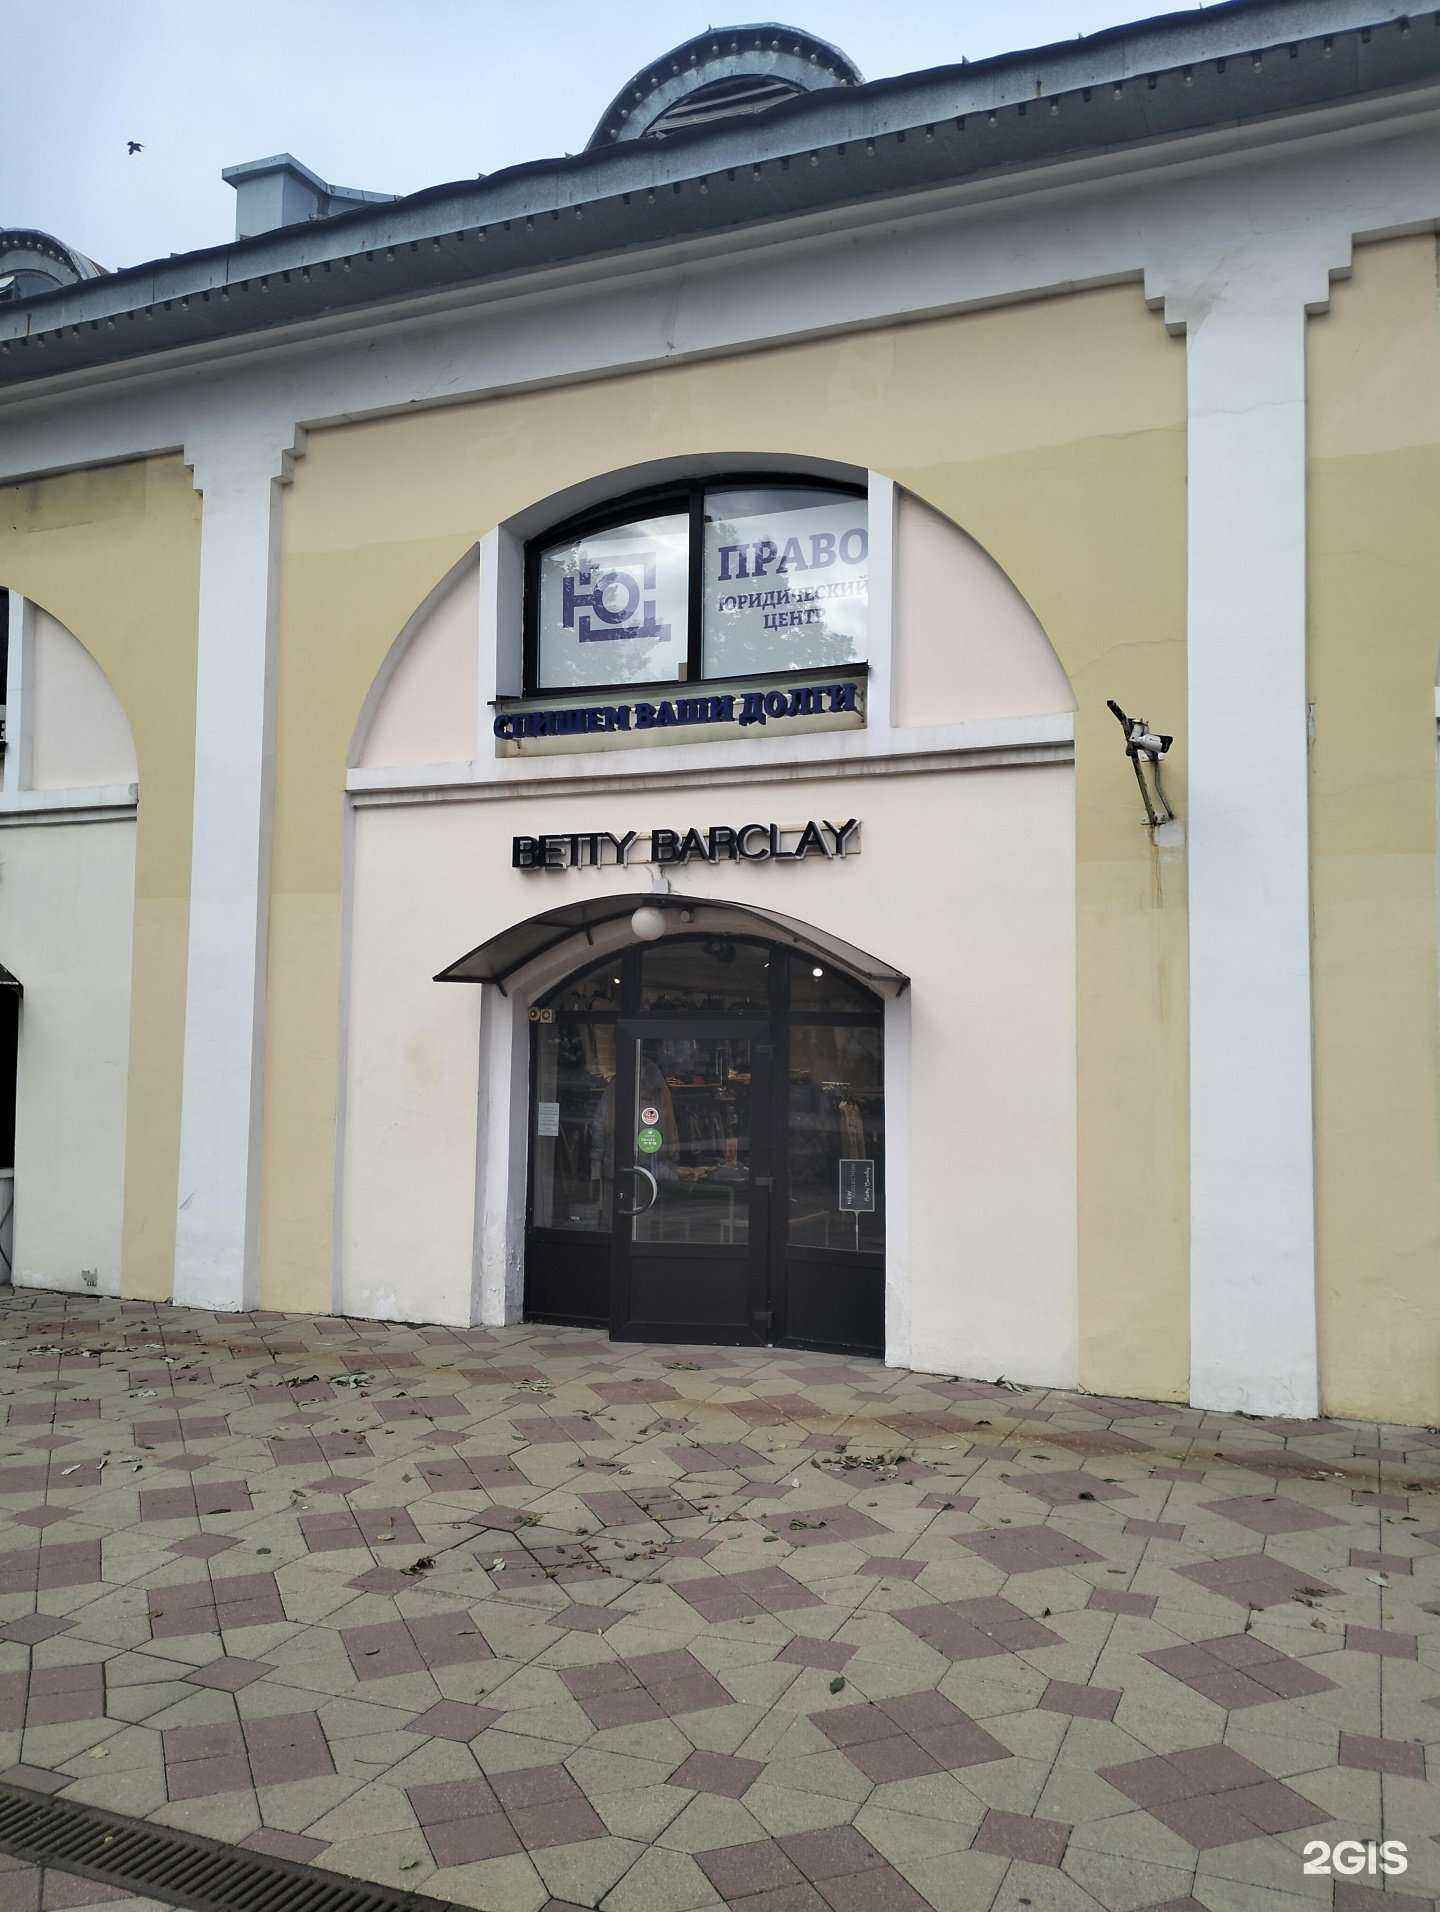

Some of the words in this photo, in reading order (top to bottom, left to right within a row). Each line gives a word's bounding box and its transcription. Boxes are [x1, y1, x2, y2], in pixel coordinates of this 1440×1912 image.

[718, 528, 869, 581] ПРАВО
[494, 704, 631, 740] СПИШЕМ
[635, 695, 735, 729] ВАШИ
[738, 683, 857, 726] ДОЛГИ
[512, 830, 639, 871] BETTY
[651, 818, 862, 865] BARCLAY
